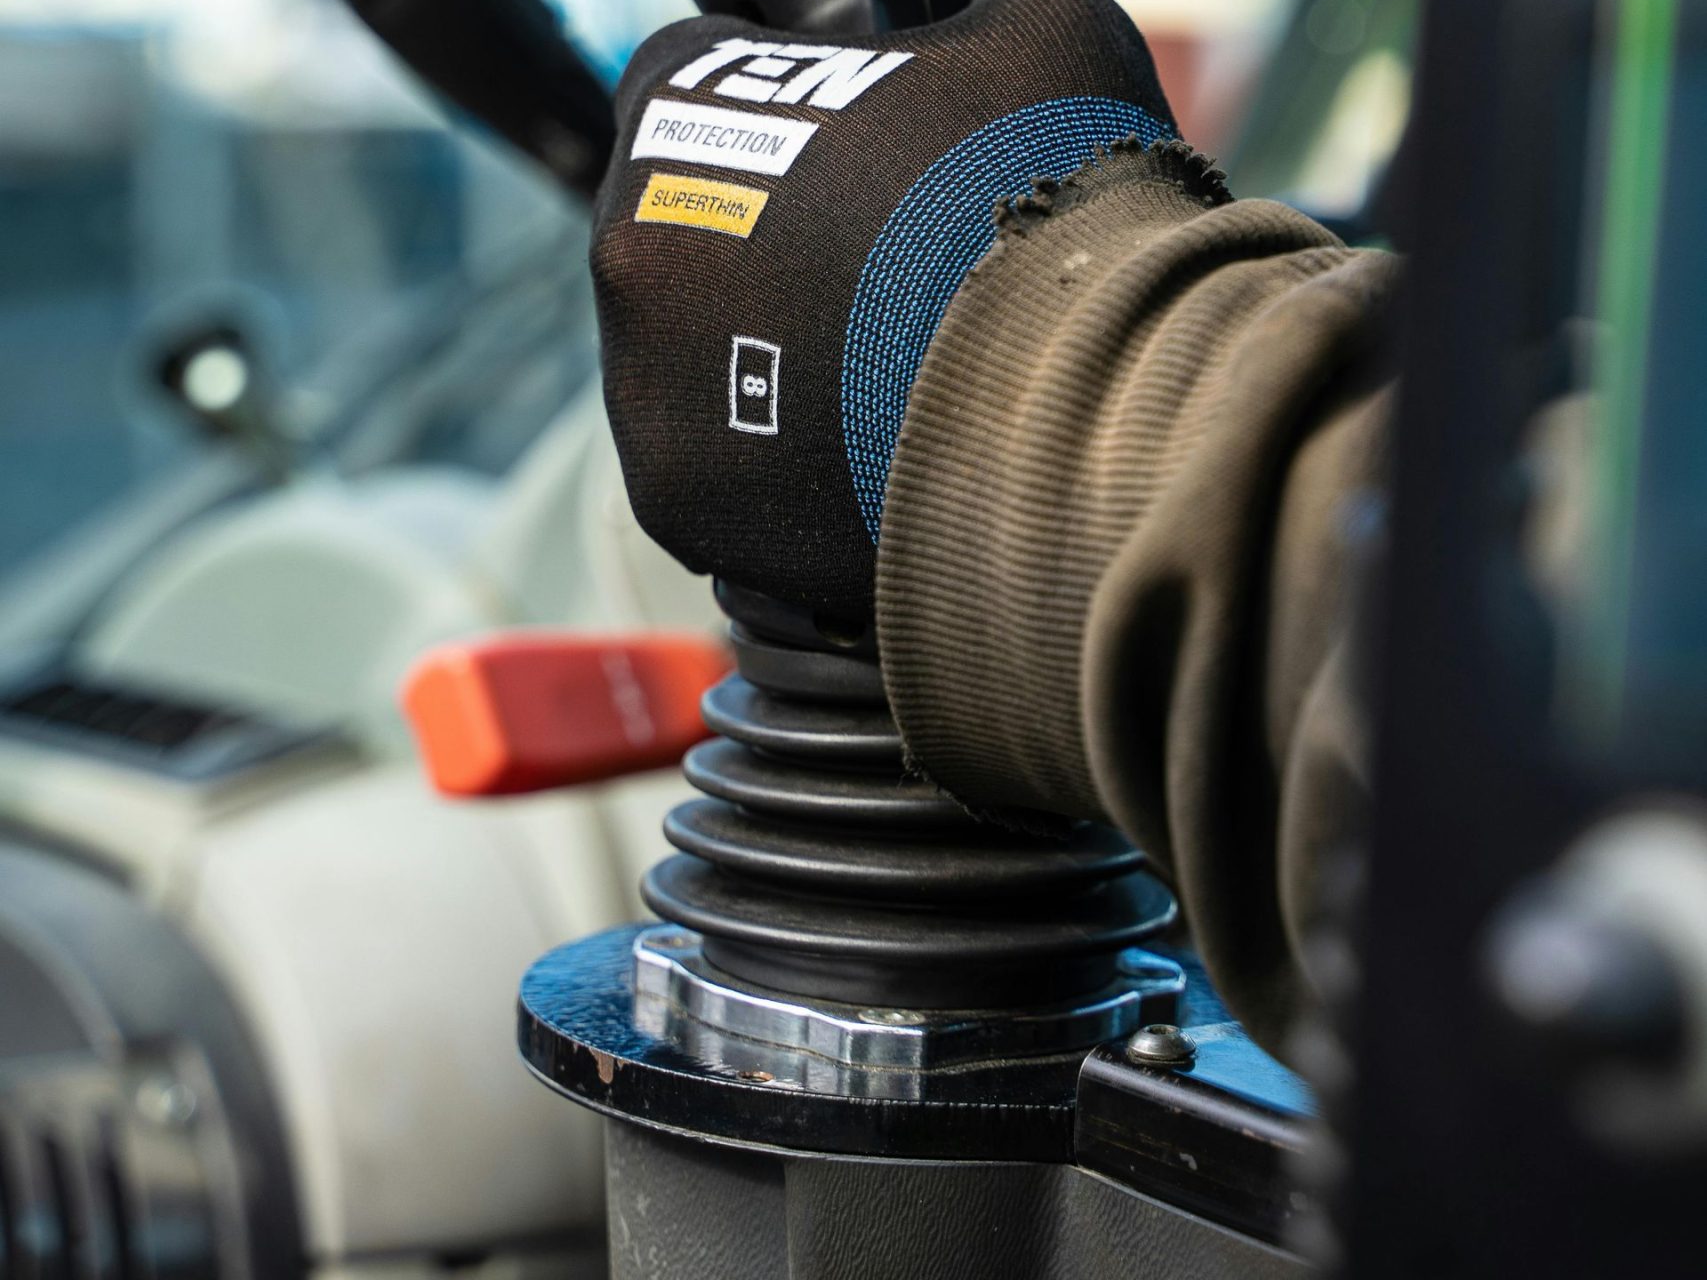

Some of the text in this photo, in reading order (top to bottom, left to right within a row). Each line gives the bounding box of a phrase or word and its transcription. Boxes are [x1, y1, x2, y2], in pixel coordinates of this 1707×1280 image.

[668, 38, 916, 111] TEN
[651, 118, 788, 157] PROTECTION
[651, 189, 751, 221] SUPERTHIN
[742, 374, 767, 397] 8
